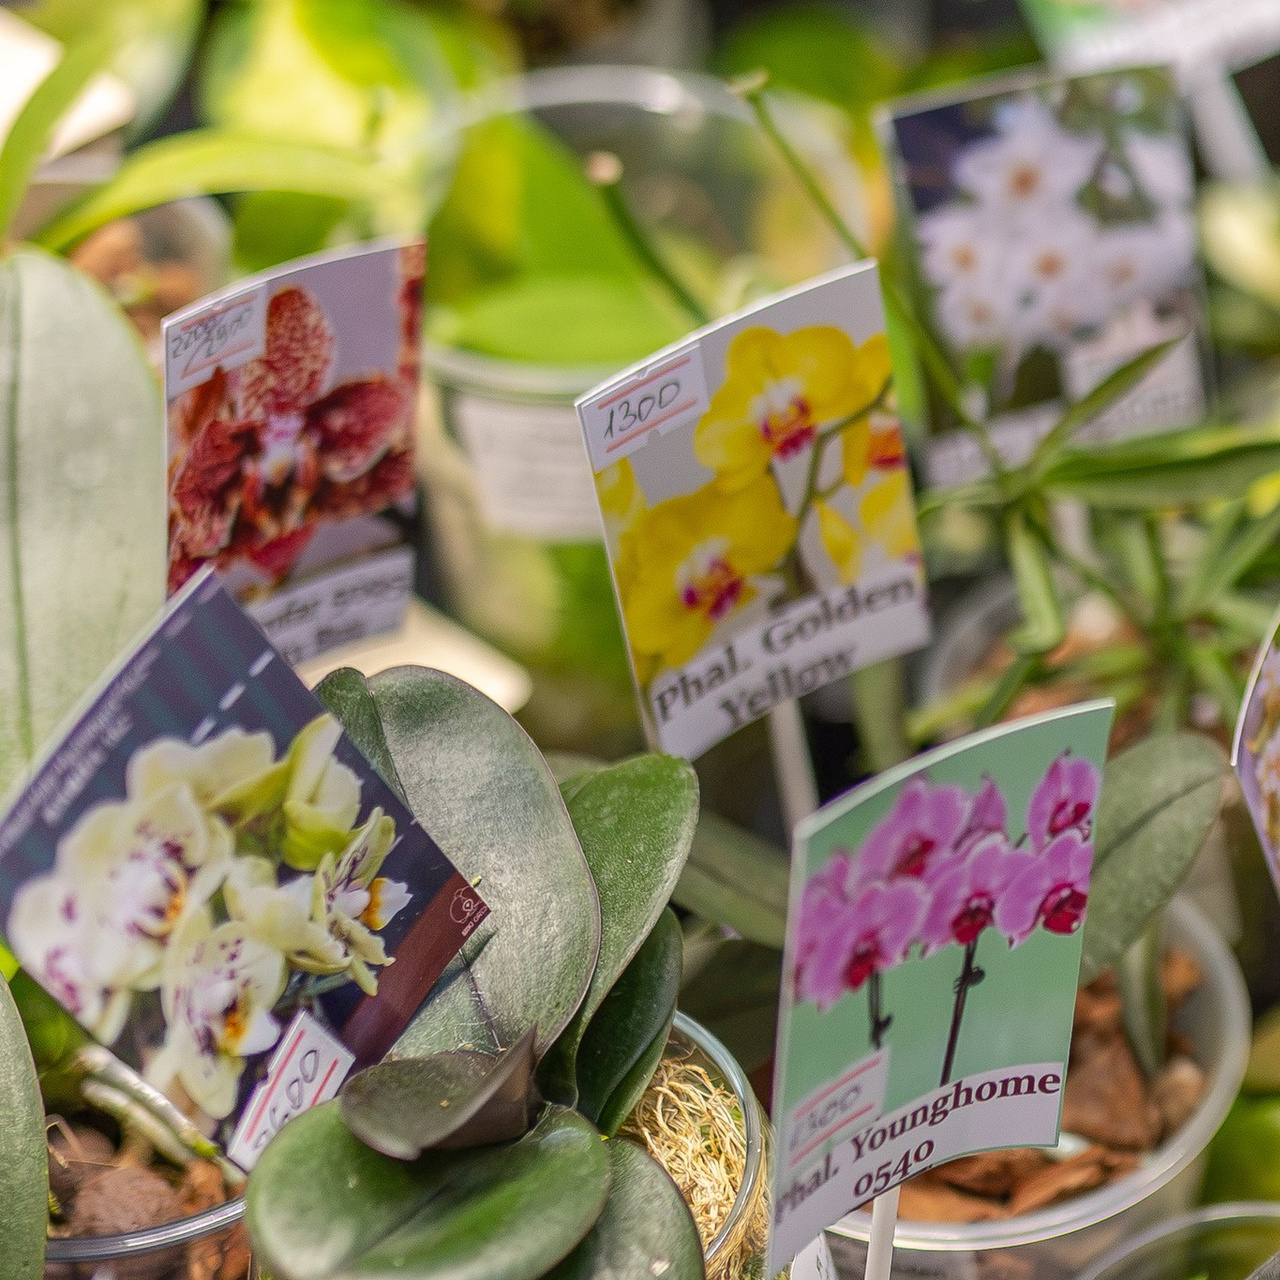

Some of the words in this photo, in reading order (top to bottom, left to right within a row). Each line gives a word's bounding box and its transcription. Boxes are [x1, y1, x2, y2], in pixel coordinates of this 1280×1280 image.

[603, 380, 681, 439] 1300
[655, 645, 752, 721] Phal.
[761, 577, 915, 654] Golden
[719, 642, 855, 724] Yellow
[851, 1072, 1061, 1163] Younghome
[853, 1139, 935, 1199] 0540
